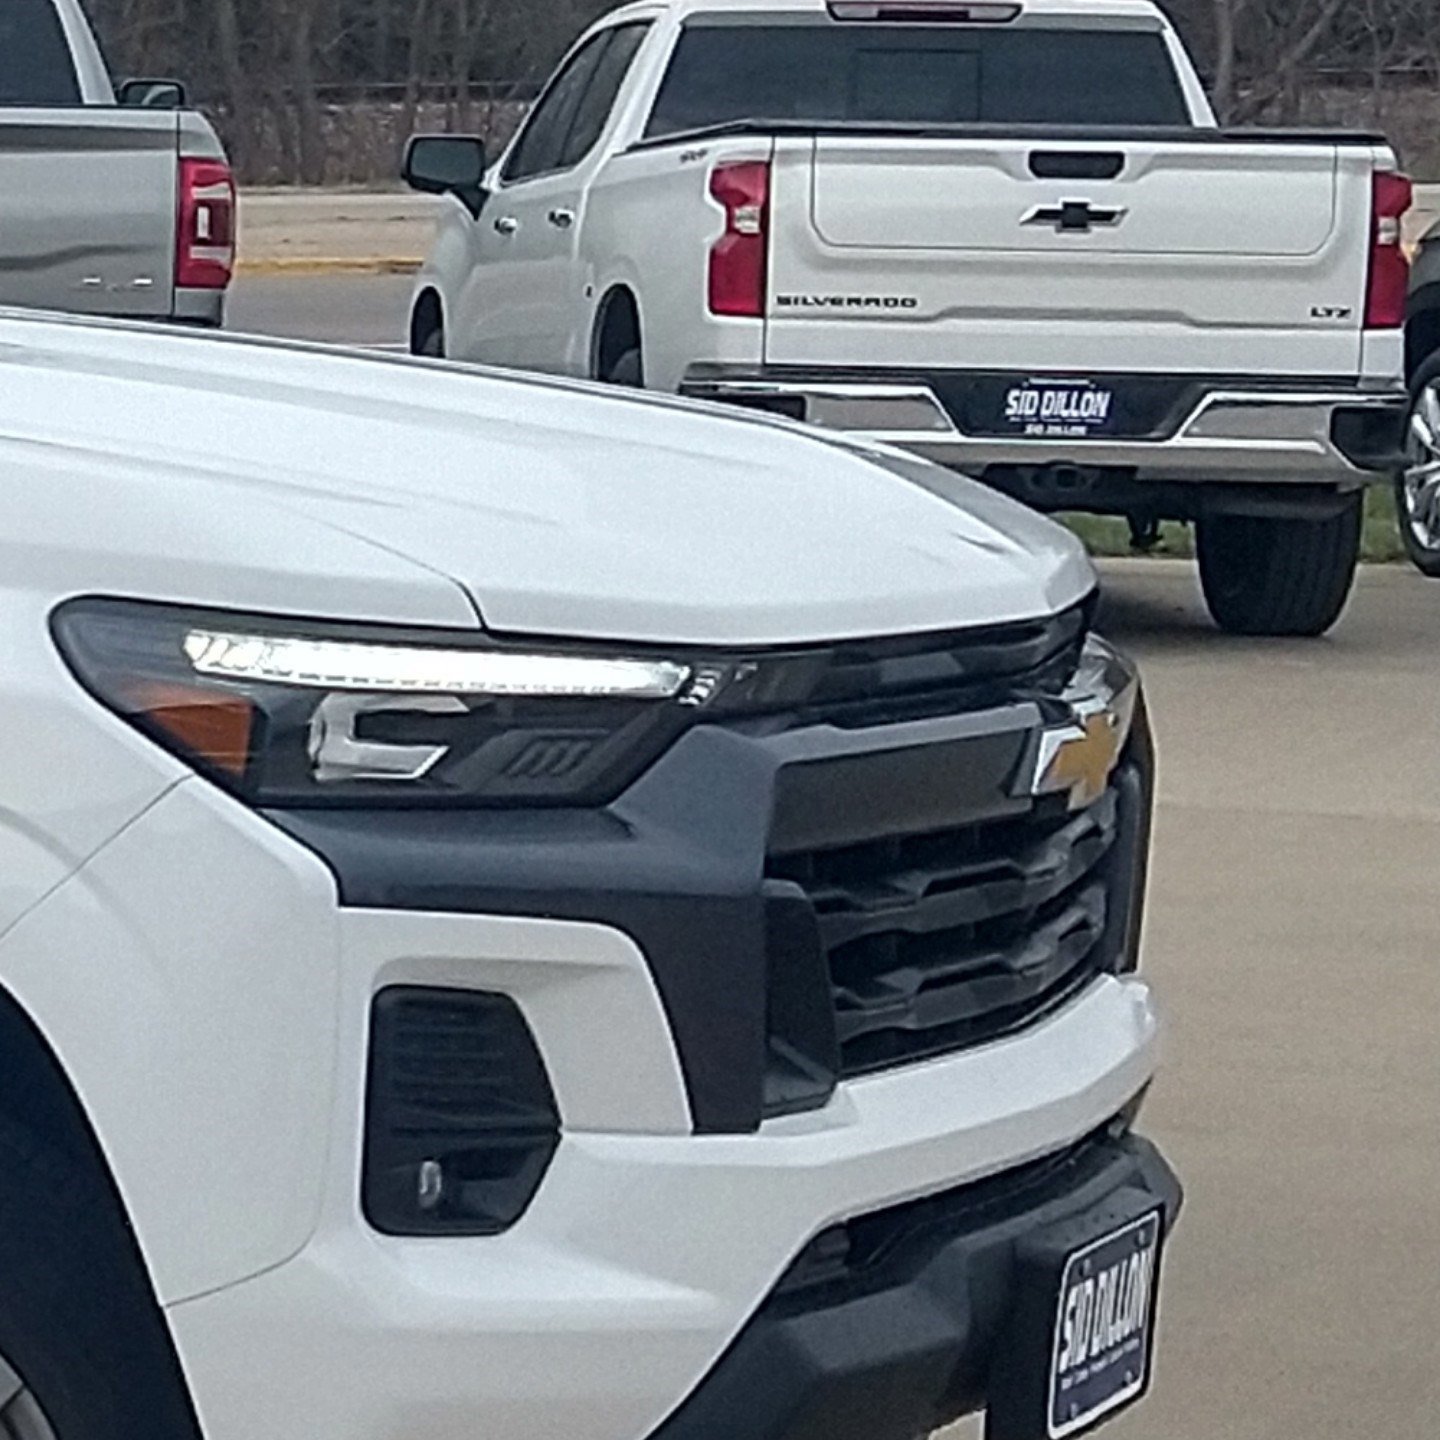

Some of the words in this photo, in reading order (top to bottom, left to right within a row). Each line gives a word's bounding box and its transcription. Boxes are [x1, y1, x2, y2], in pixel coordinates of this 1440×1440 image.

[776, 294, 918, 308] SILVERADO
[1310, 306, 1352, 319] LTZ
[1004, 388, 1040, 416] SID
[1040, 389, 1112, 418] DILLON
[1058, 1277, 1096, 1374] SID
[1090, 1247, 1154, 1357] DILLON
